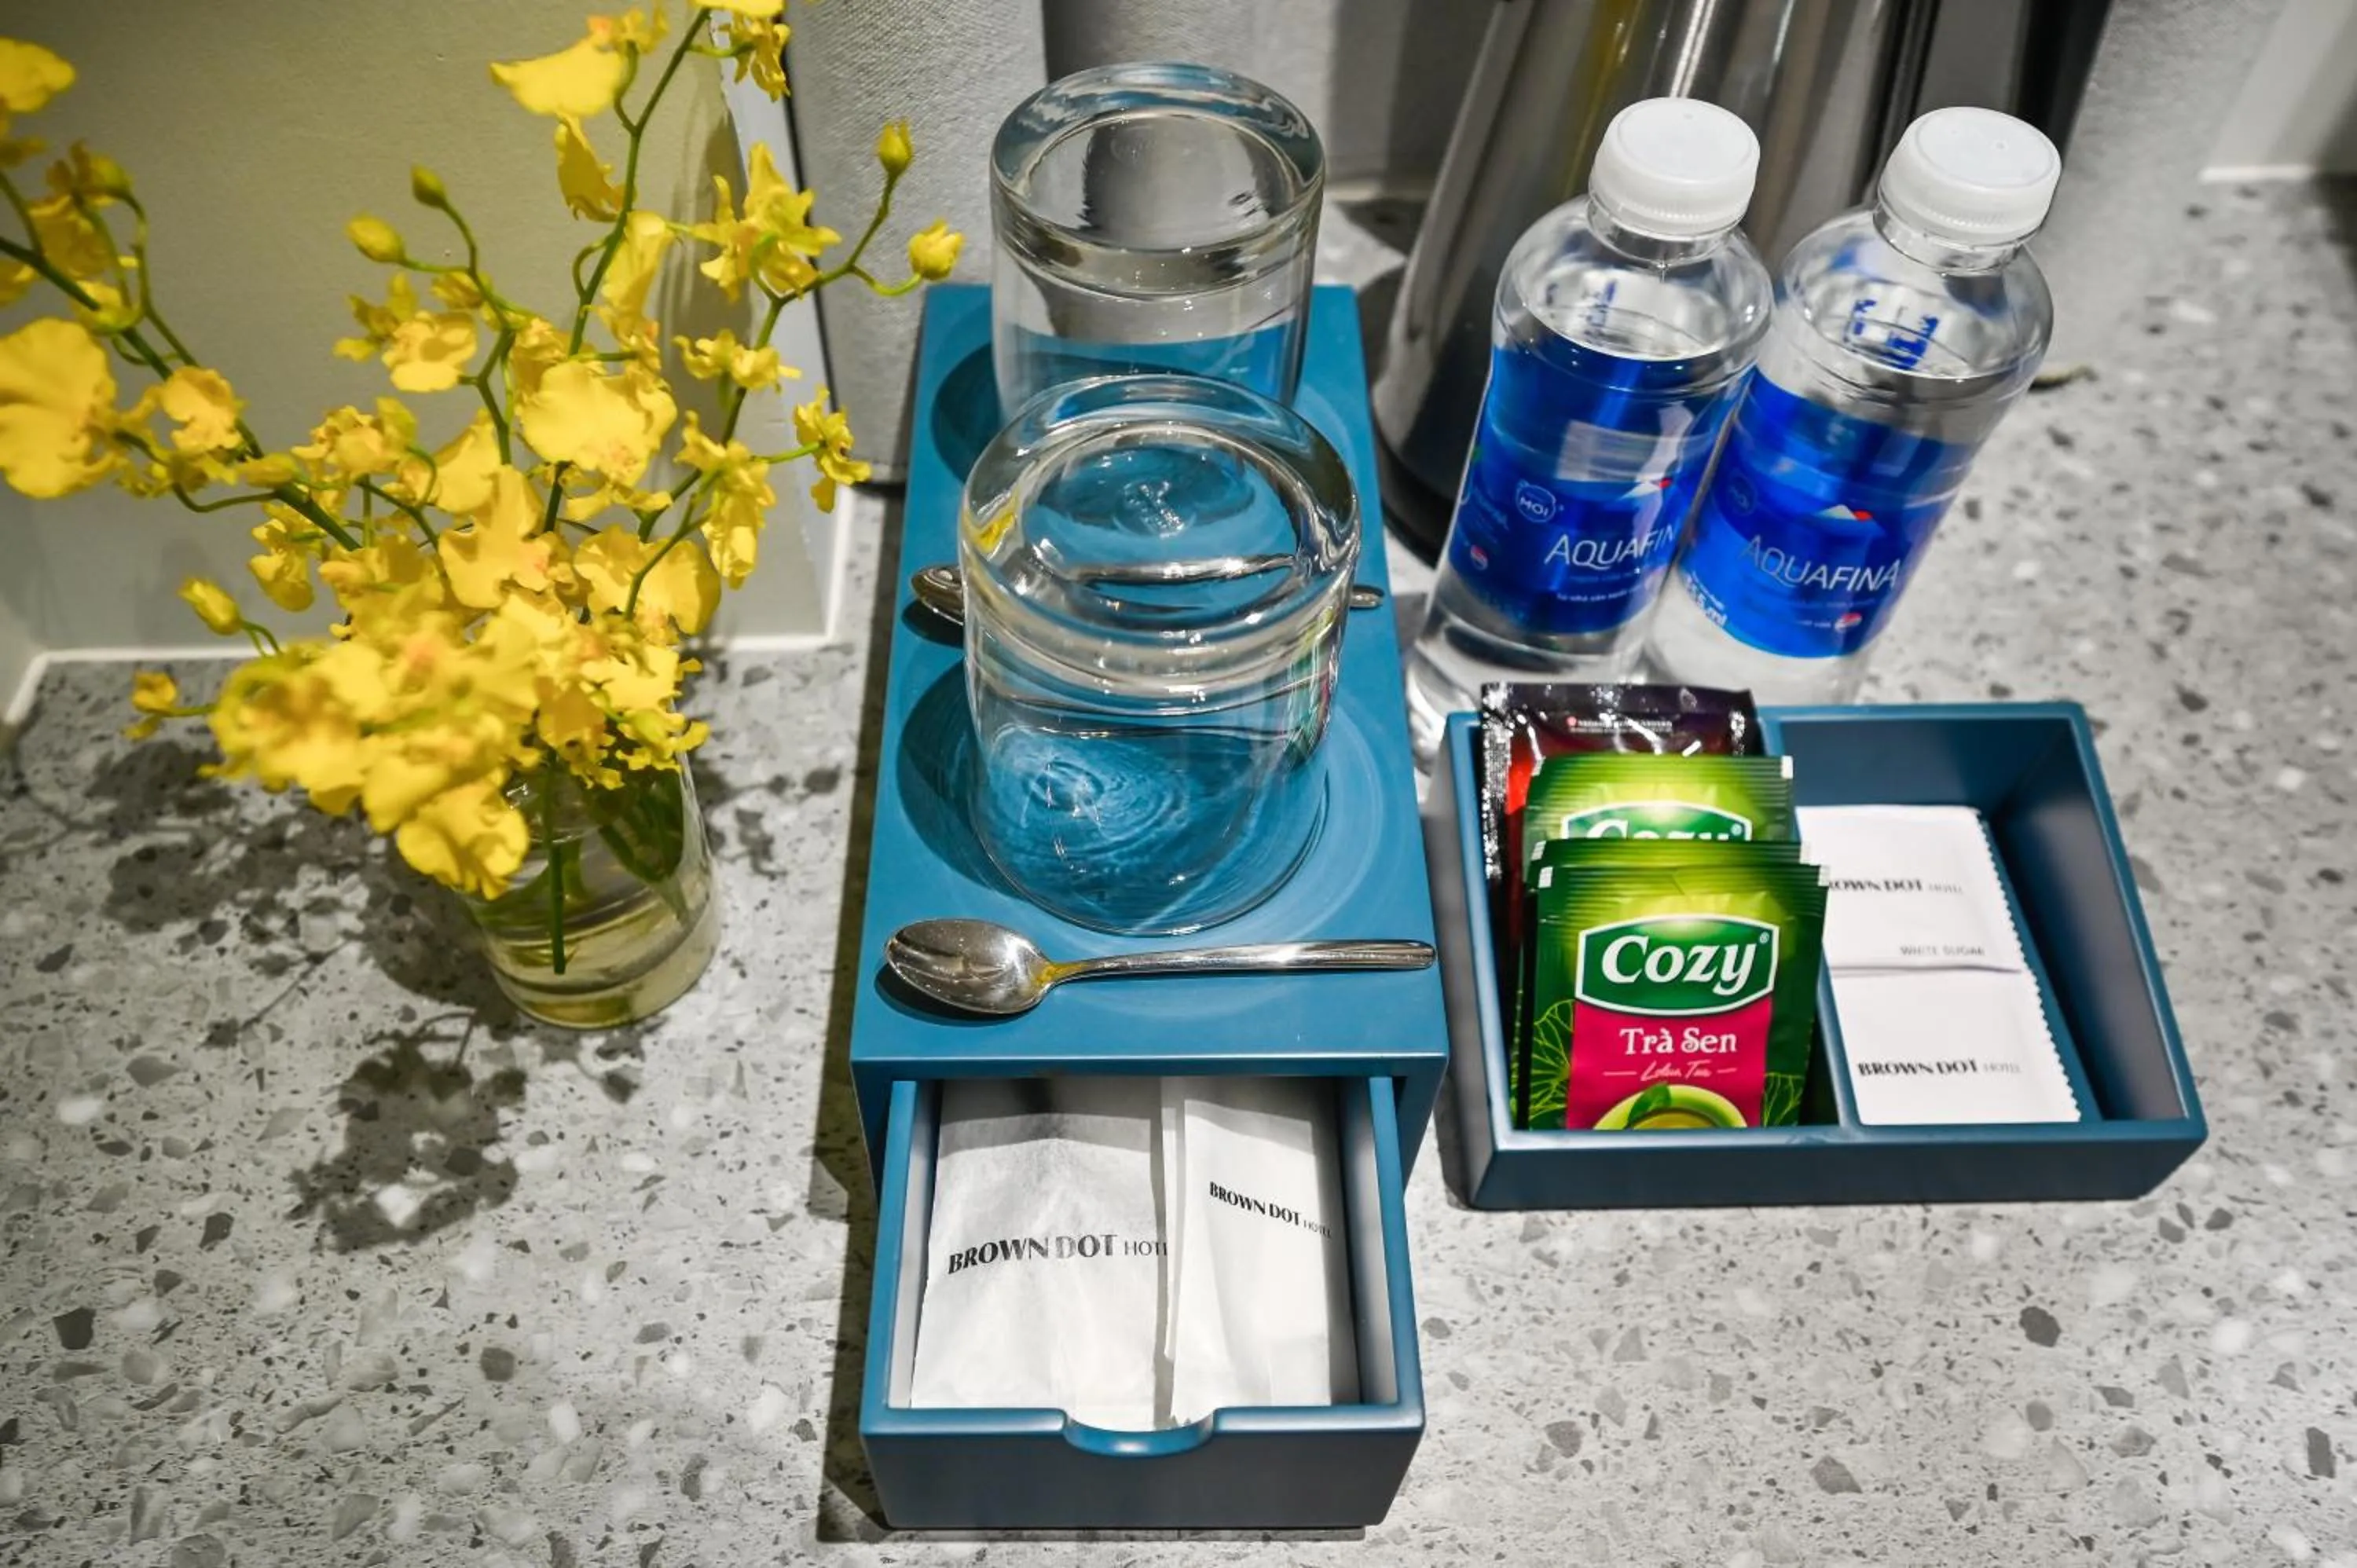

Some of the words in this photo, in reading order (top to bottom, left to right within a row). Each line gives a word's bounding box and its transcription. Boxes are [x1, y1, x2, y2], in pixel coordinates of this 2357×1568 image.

[1743, 534, 1901, 591] AQUAFINA
[1884, 879, 1923, 892] DOT
[1601, 935, 1757, 995] Cozy
[1901, 945, 1938, 955] WHITE
[1619, 1028, 1674, 1055] Trà
[1681, 1027, 1737, 1053] Sen
[1857, 1062, 1934, 1076] BROWN
[1936, 1059, 1978, 1074] DOT
[1210, 1181, 1266, 1215] BROWN
[1269, 1203, 1300, 1225] DOT
[948, 1236, 1049, 1274] BROWN
[1055, 1234, 1118, 1259] DOT
